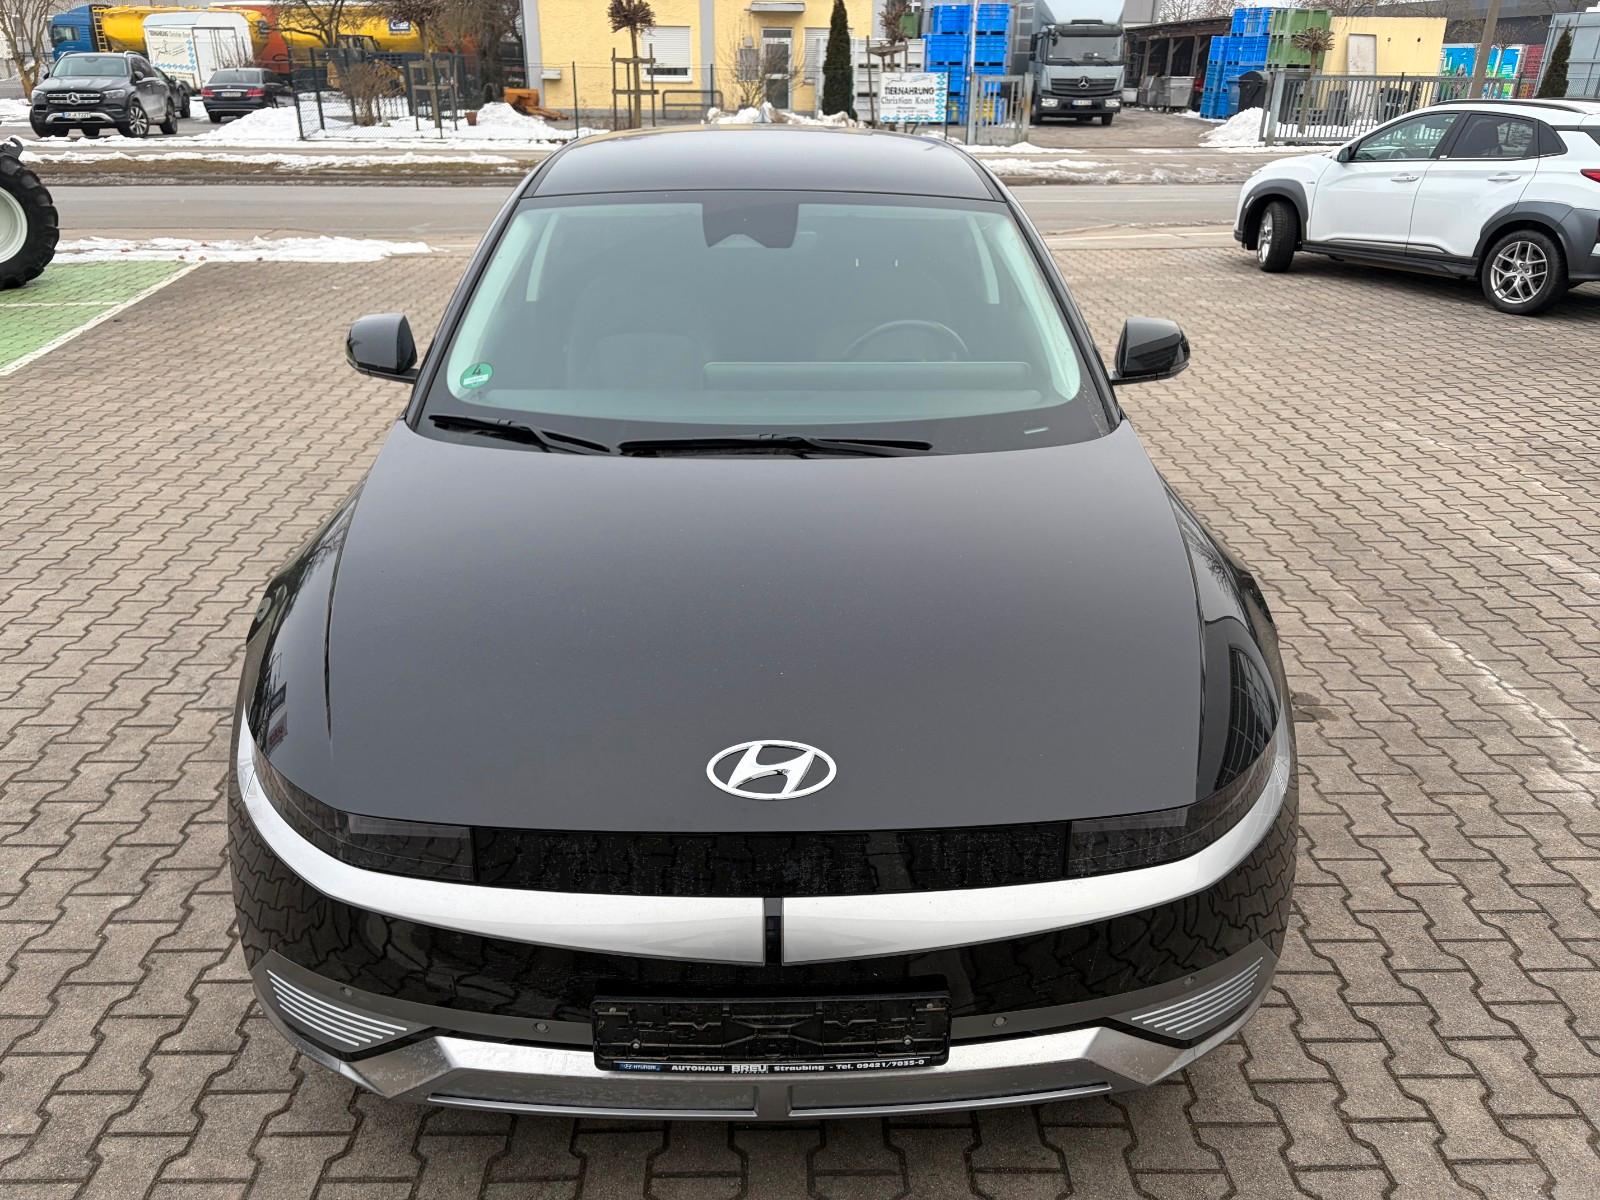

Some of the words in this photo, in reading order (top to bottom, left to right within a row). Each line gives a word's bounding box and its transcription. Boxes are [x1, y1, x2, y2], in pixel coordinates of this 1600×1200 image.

[885, 87, 935, 95] TIERNAHRUNG
[881, 96, 912, 104] Christian
[731, 1064, 767, 1072] BREU
[773, 1064, 825, 1072] Straubing
